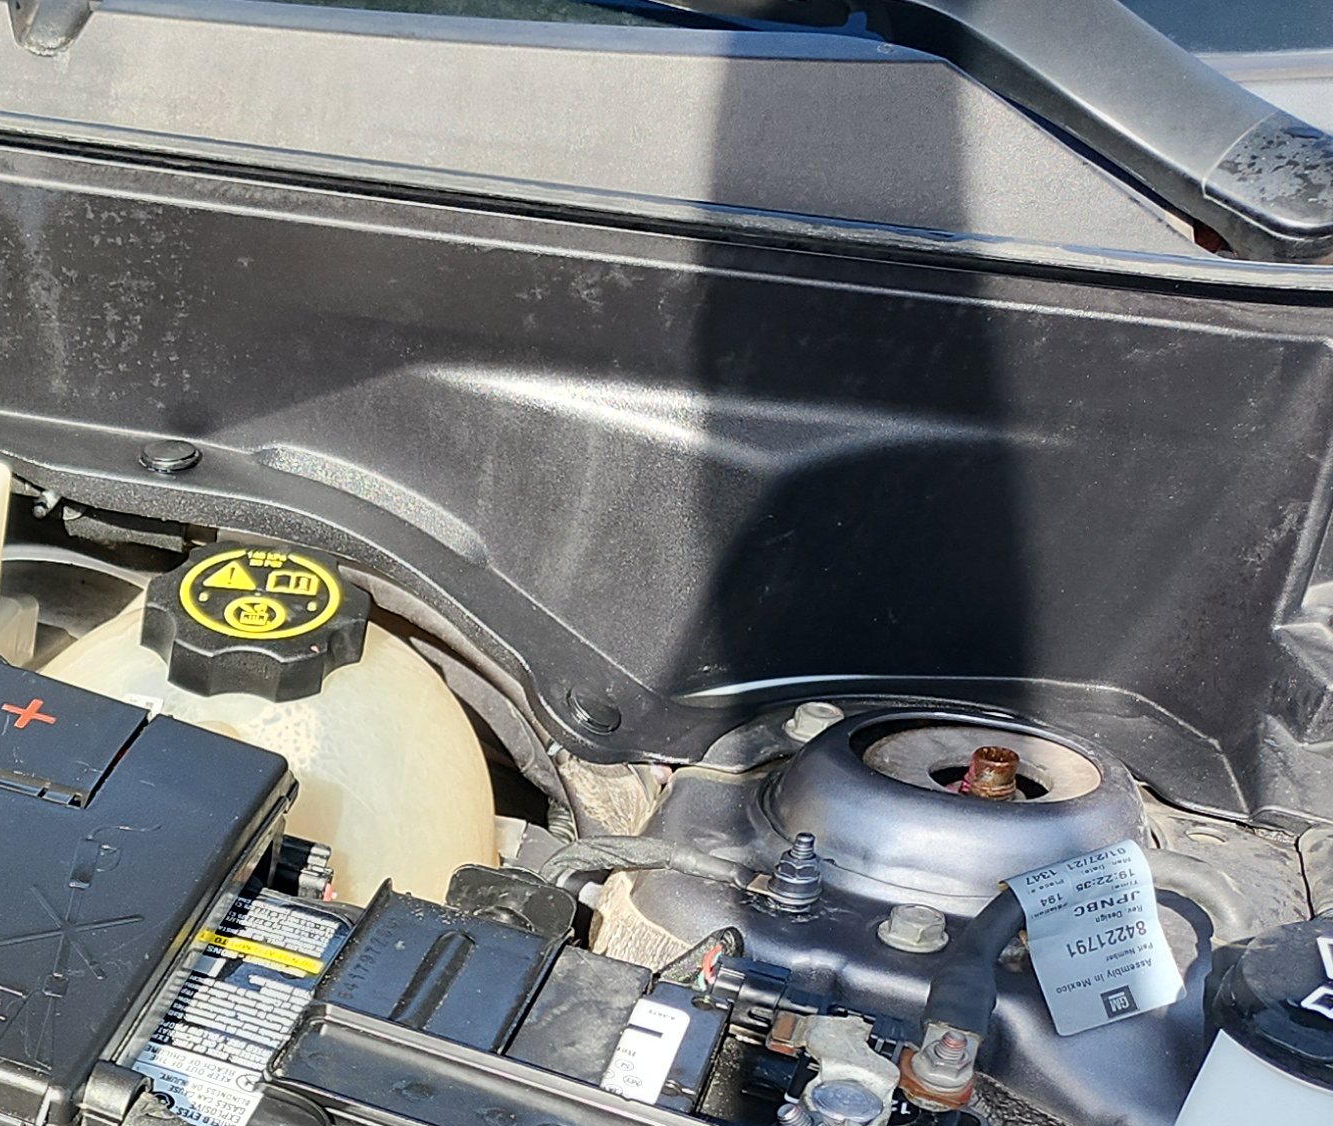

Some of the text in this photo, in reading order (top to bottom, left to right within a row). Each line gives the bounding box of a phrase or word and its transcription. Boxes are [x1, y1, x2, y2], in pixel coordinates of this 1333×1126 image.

[1067, 847, 1126, 871] 01/27/21
[1025, 869, 1057, 886] 1347
[1075, 868, 1135, 893] 19:22:35
[1040, 892, 1063, 907] 194
[1073, 890, 1140, 917] JPNBC
[1095, 910, 1122, 923] Design
[213, 936, 227, 945] TO
[1066, 920, 1146, 958] 84221791
[1056, 958, 1152, 994] Assembly in Mexico
[1110, 996, 1130, 1012] GM
[173, 1105, 201, 1121] EYES.
[215, 1099, 246, 1115] GASES
